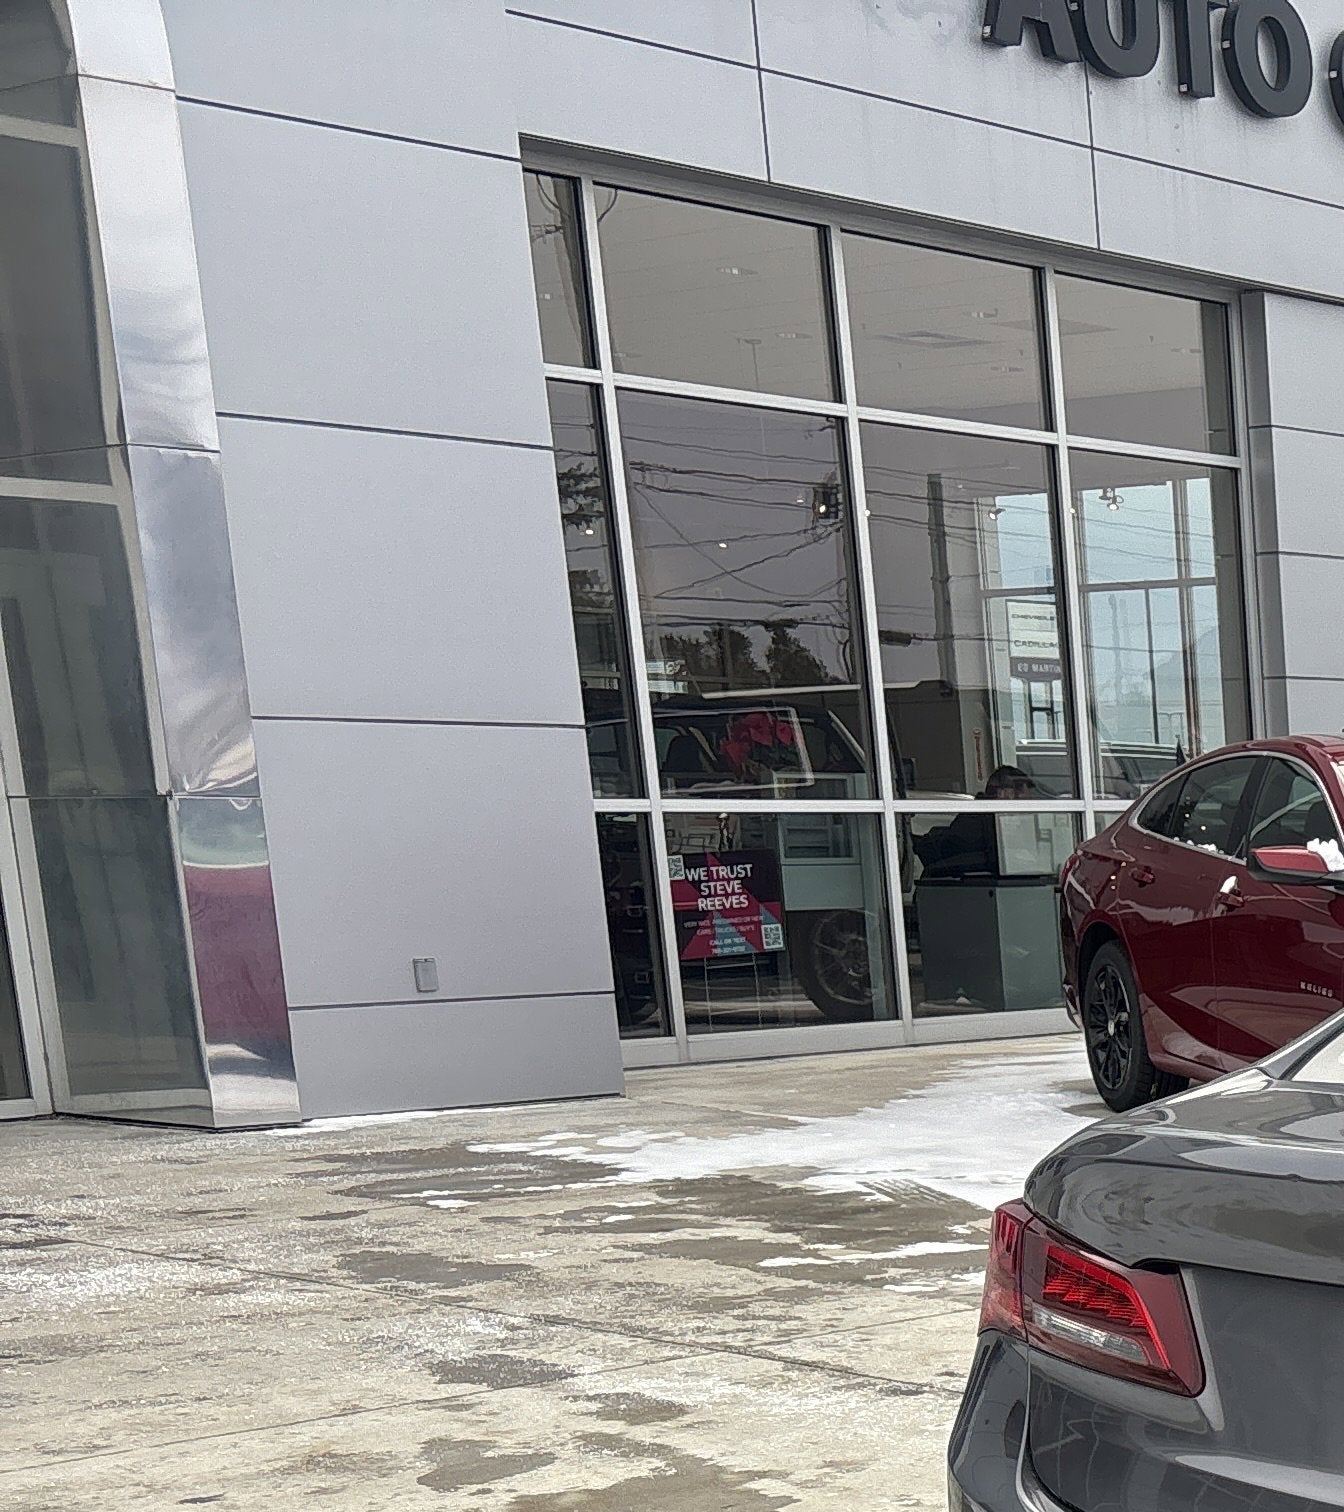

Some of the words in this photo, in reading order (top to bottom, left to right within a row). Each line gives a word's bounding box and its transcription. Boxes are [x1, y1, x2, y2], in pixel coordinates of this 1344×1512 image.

[685, 867, 708, 881] WE
[710, 864, 753, 880] TRUST
[700, 880, 742, 896] STEVE
[697, 895, 749, 911] REEVES
